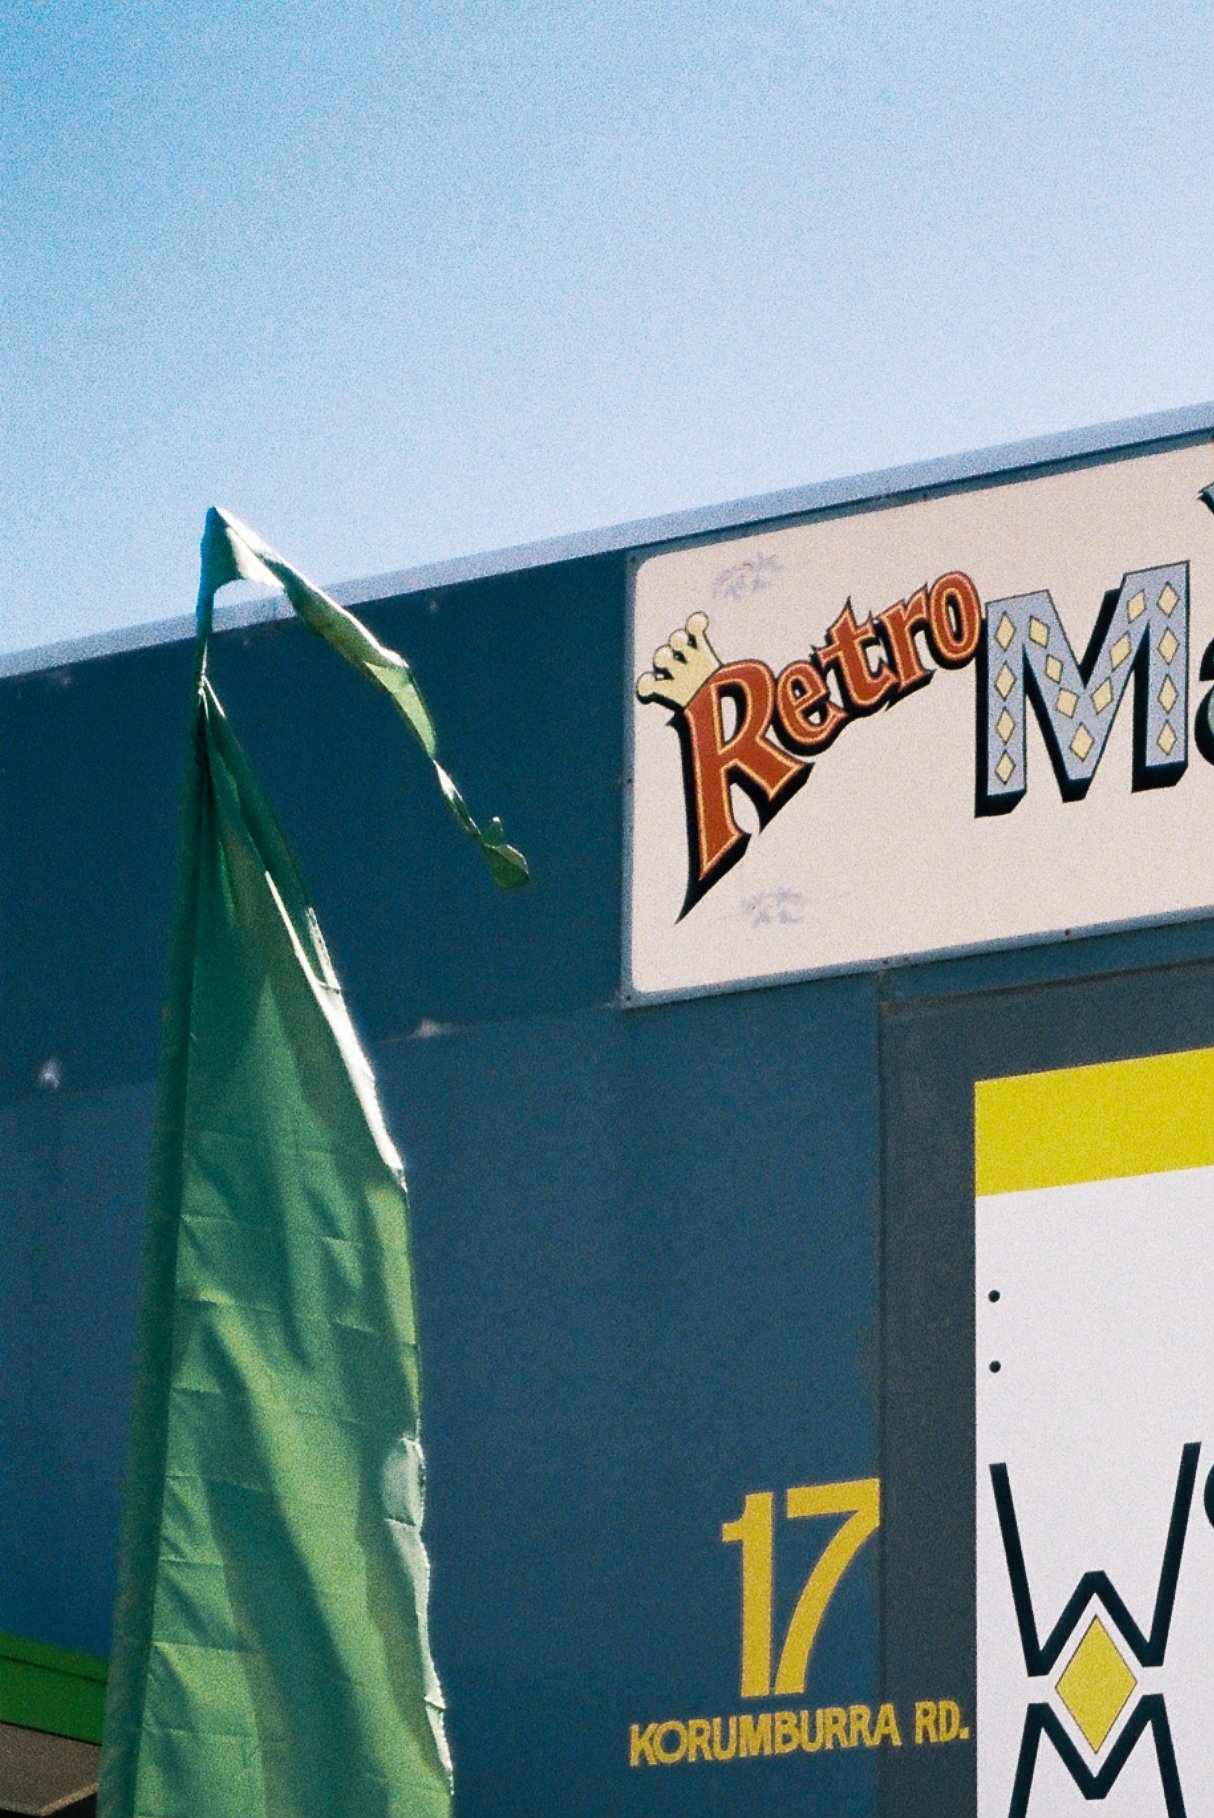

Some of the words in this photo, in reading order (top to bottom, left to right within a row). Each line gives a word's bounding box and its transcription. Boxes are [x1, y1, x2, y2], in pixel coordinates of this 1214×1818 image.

[674, 570, 982, 924] Retro
[722, 1478, 880, 1698] 17
[629, 1703, 902, 1767] KORUMBURRA
[915, 1700, 970, 1744] RD.
